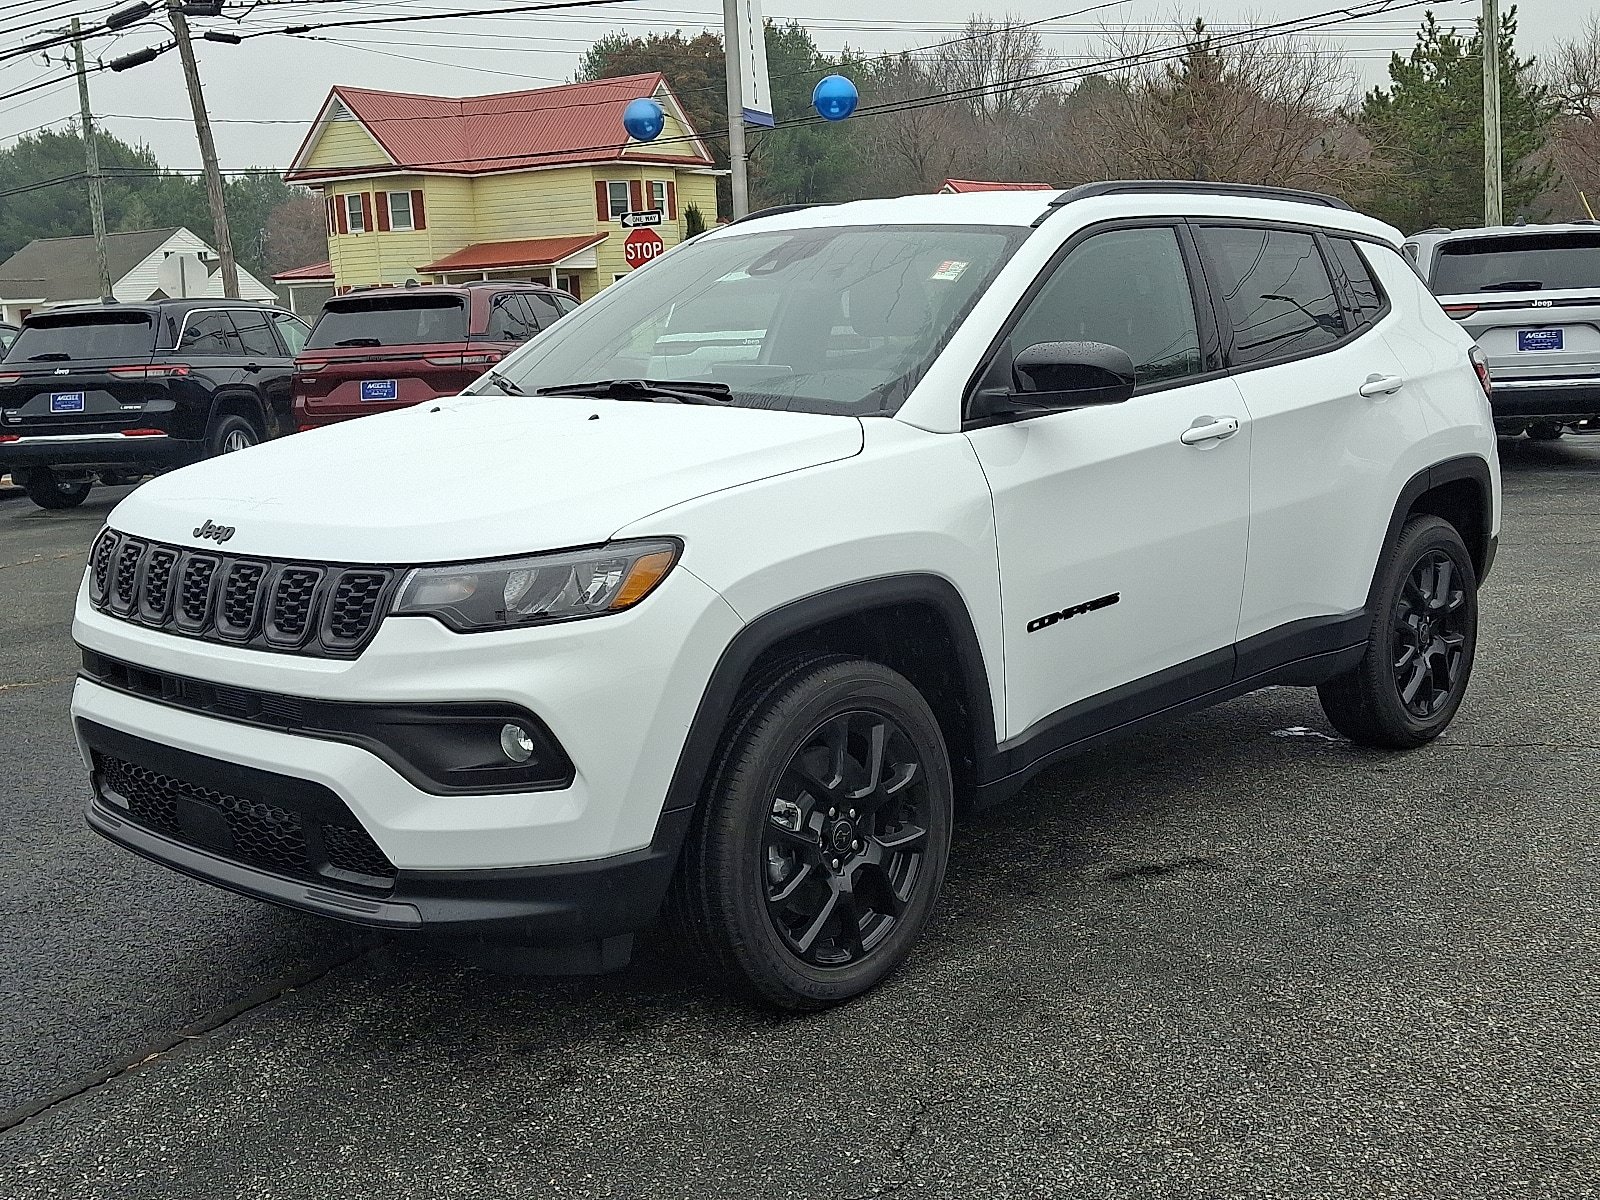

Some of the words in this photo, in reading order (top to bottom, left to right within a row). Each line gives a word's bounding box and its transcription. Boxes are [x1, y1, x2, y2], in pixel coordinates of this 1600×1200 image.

[645, 214, 657, 222] WAY
[626, 241, 662, 260] STOP
[1531, 299, 1553, 308] Jeep
[193, 519, 236, 545] Jeep
[1026, 591, 1121, 634] COMPASS
